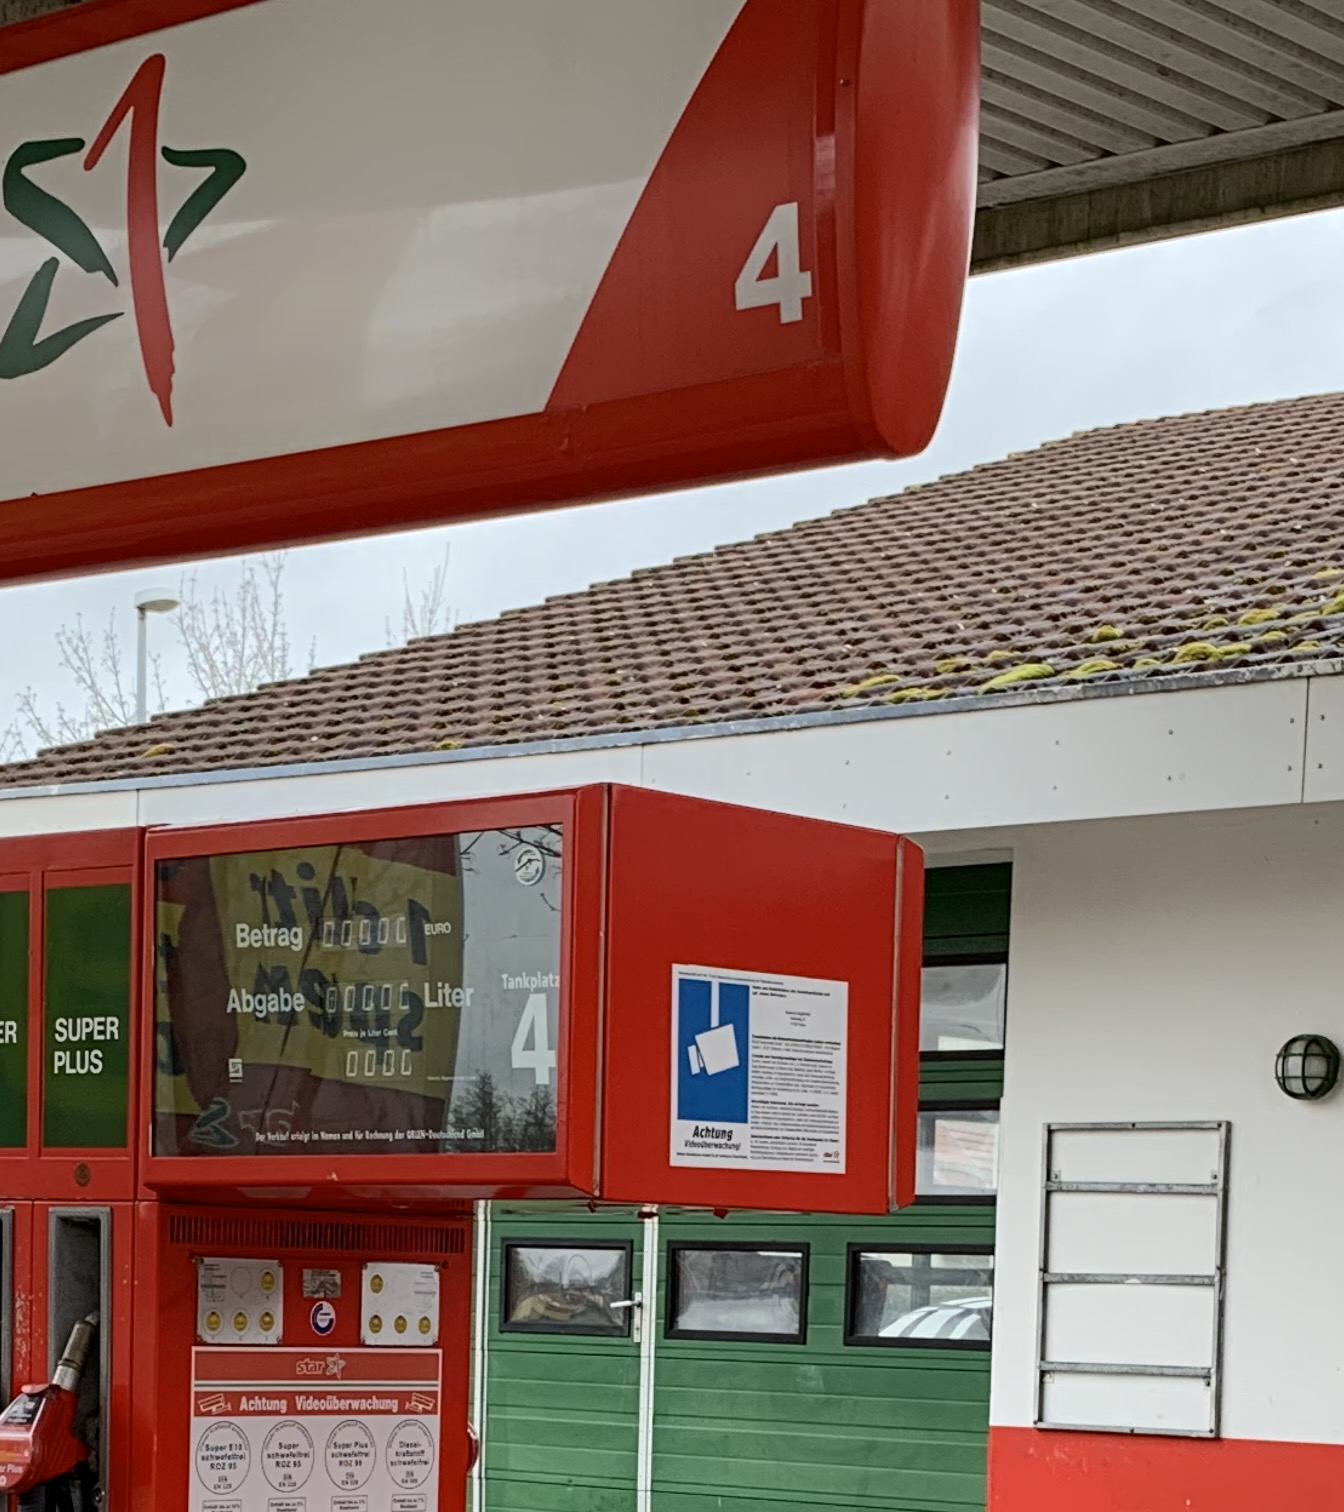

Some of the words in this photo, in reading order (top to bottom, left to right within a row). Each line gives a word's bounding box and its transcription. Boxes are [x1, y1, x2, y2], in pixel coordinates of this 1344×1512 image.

[735, 202, 812, 324] 4
[236, 923, 303, 951] Betrag
[424, 922, 452, 935] EURO
[501, 972, 560, 992] Tankplatz
[227, 987, 305, 1017] Abgabe
[424, 982, 474, 1008] Liter
[55, 1016, 119, 1042] SUPER
[368, 1029, 381, 1037] Liter
[511, 993, 556, 1085] 4
[54, 1049, 103, 1074] PLUS
[342, 1131, 353, 1140] und
[692, 1125, 733, 1141] Achtung
[296, 1358, 325, 1375] star
[239, 1396, 287, 1413] Achtung
[295, 1395, 398, 1413] Videoüberwachung
[205, 1444, 227, 1452] Super
[278, 1442, 299, 1450] Super
[6, 1464, 23, 1473] Plus
